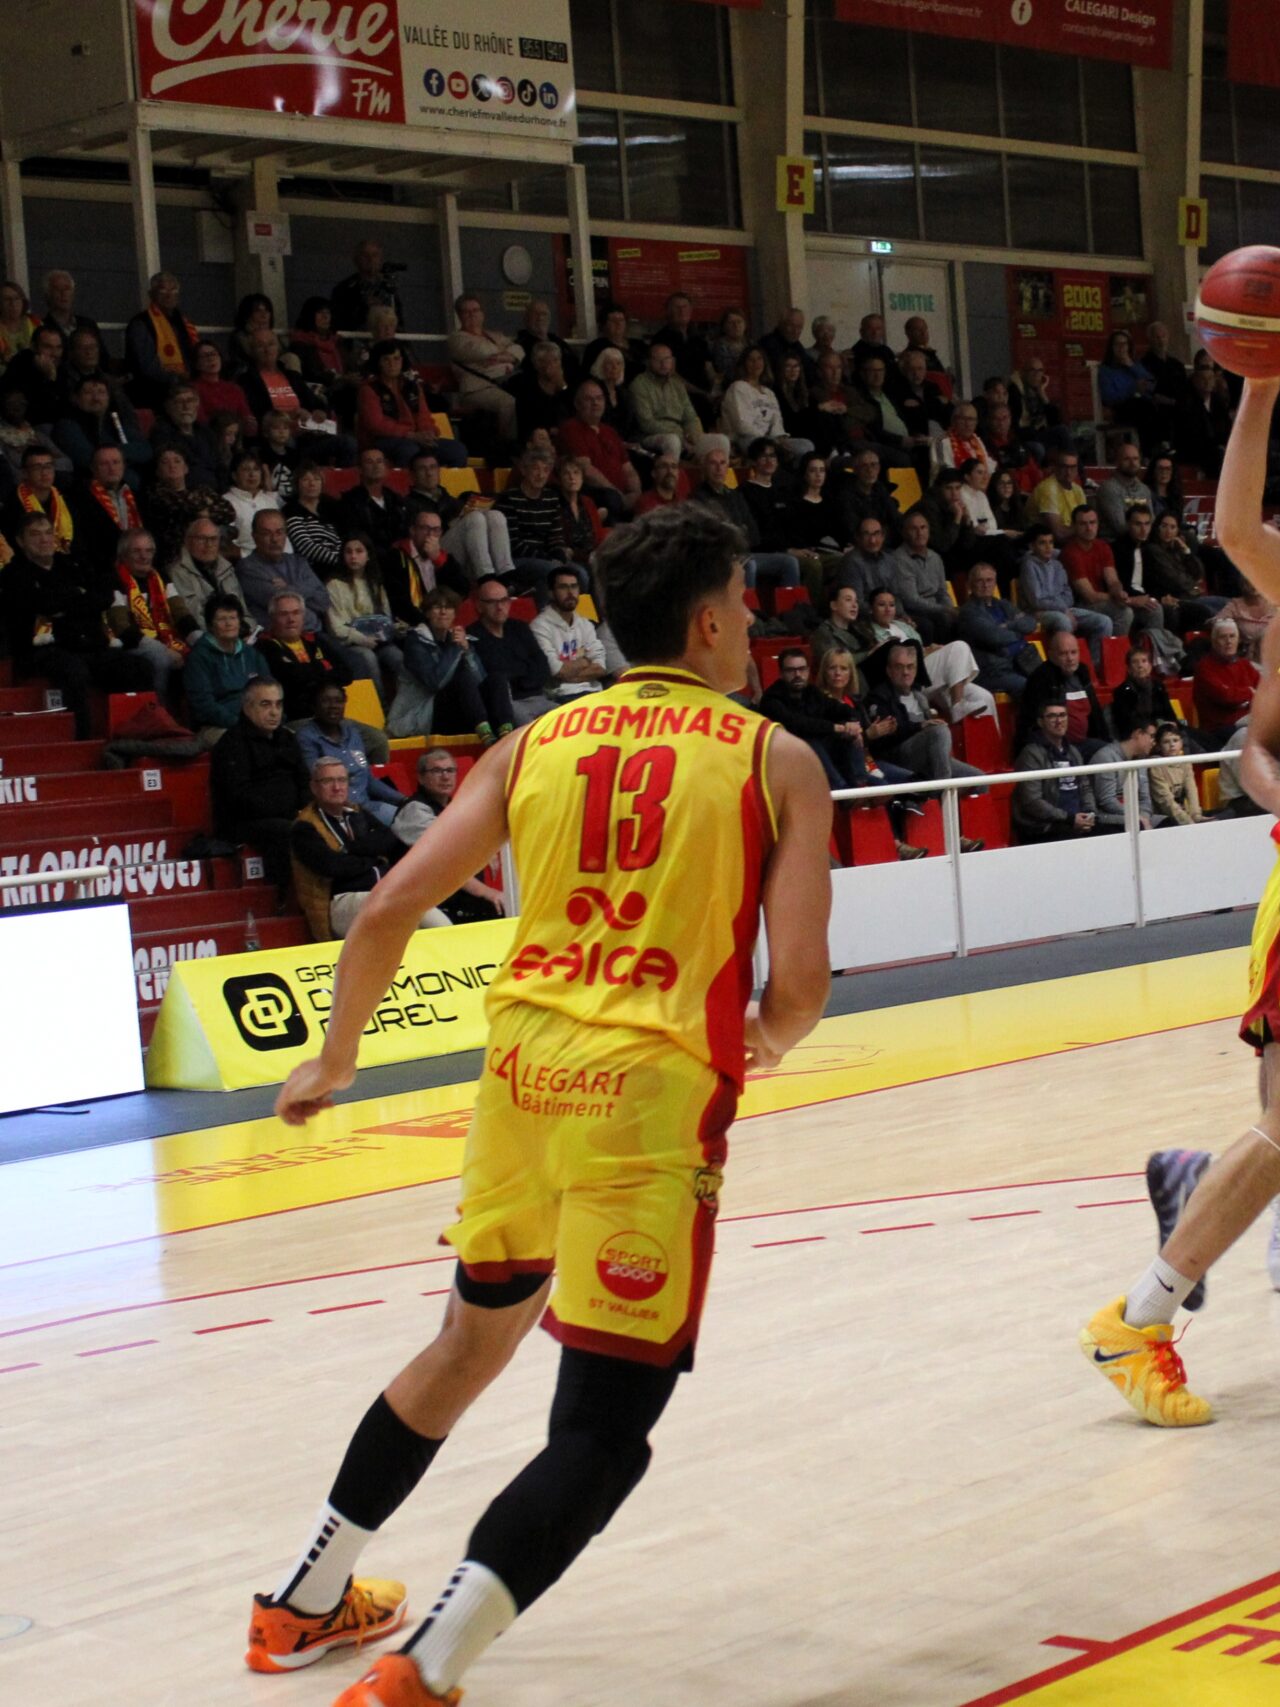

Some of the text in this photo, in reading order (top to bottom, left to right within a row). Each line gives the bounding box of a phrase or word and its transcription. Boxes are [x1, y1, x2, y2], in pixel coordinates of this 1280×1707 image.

[1064, 0, 1156, 29] CALEGARI Design
[404, 25, 514, 55] VALLÉE DU RHÔNE
[787, 165, 804, 205] E
[1186, 205, 1199, 239] D
[889, 293, 935, 312] SORTIE
[1063, 284, 1101, 309] 2003
[540, 705, 747, 746] JOGMINAS
[577, 744, 677, 874] 13
[511, 941, 678, 992] SAICA
[489, 1043, 627, 1106] CALEGARI
[521, 1093, 615, 1118] Bâtiment
[606, 1248, 661, 1269] SPORT
[607, 1263, 656, 1283] 2000
